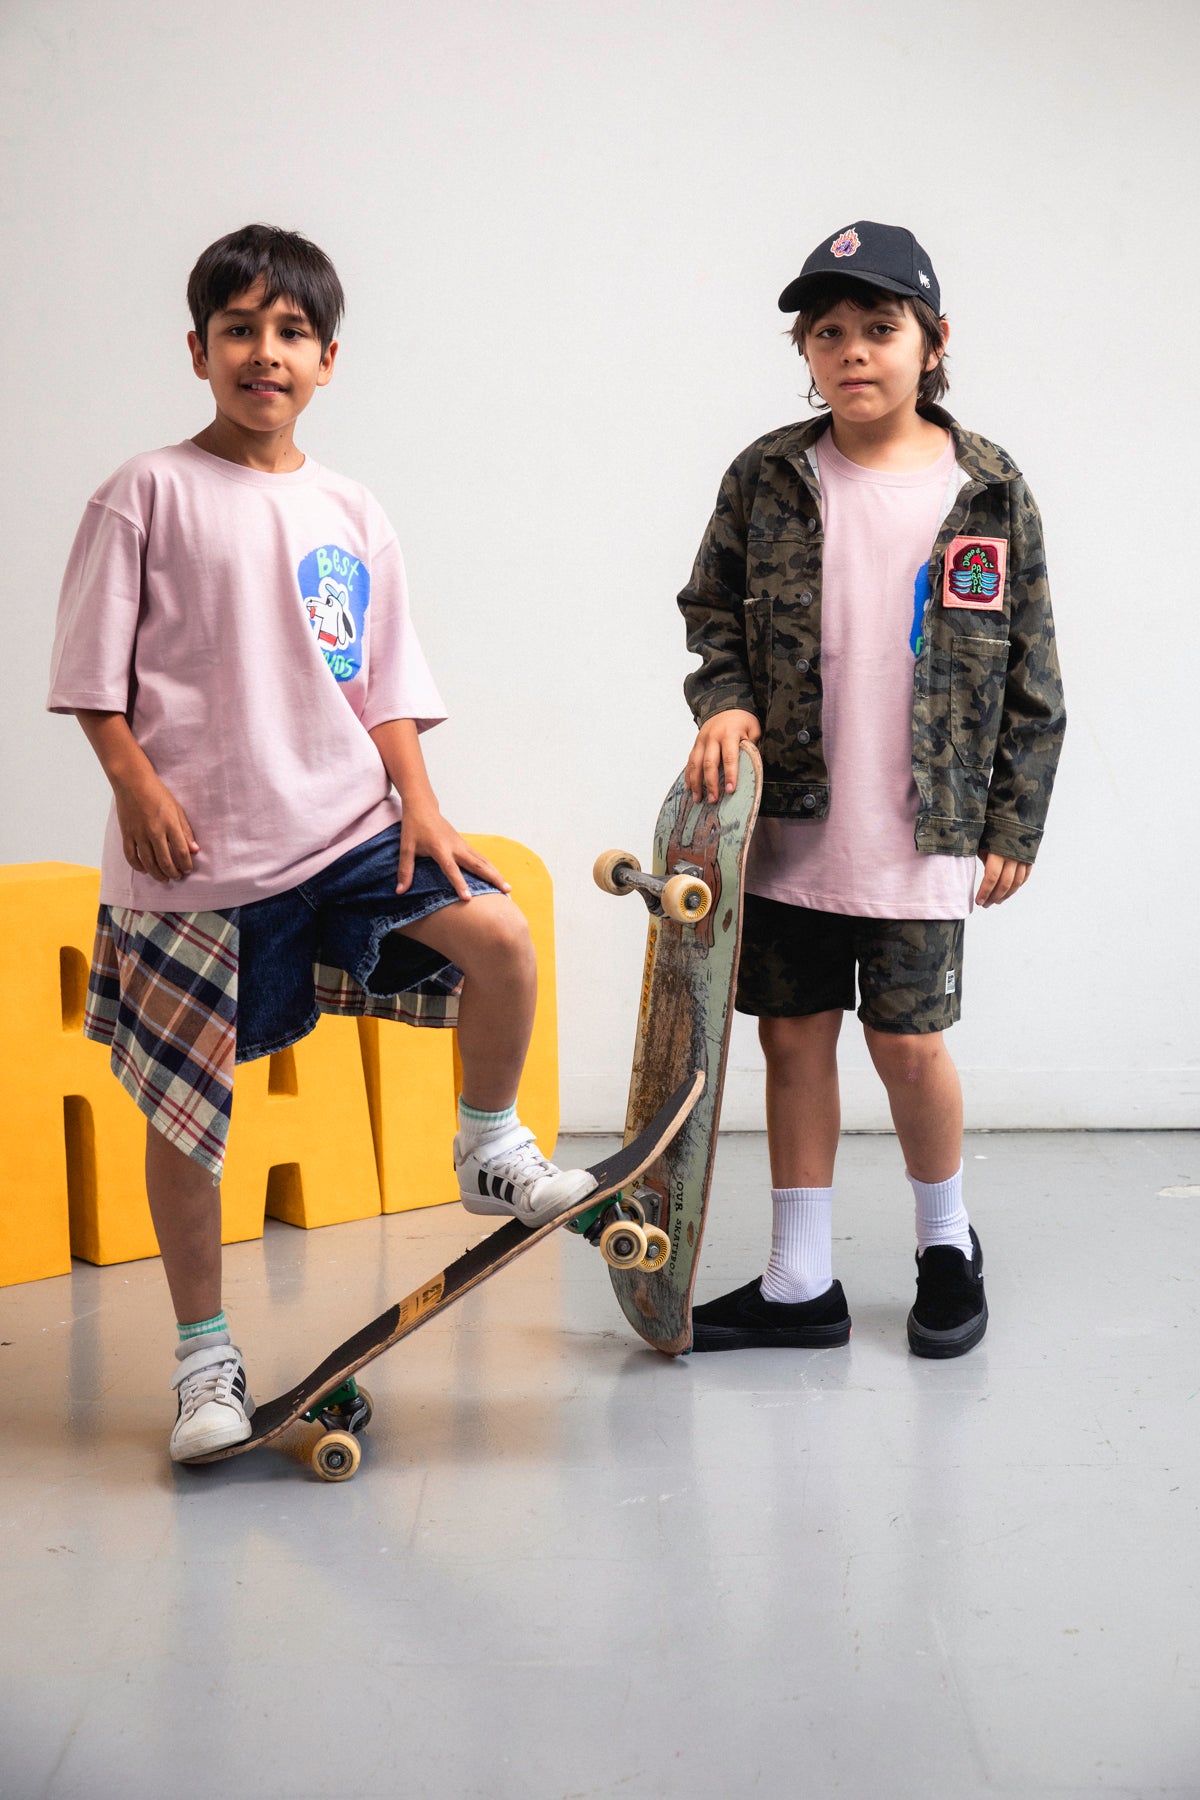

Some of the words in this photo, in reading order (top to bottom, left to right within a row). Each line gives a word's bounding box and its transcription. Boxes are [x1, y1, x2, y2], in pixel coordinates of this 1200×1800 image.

[316, 548, 360, 591] Best
[674, 1176, 685, 1212] OUR
[667, 1217, 683, 1278] SKATEBOA
